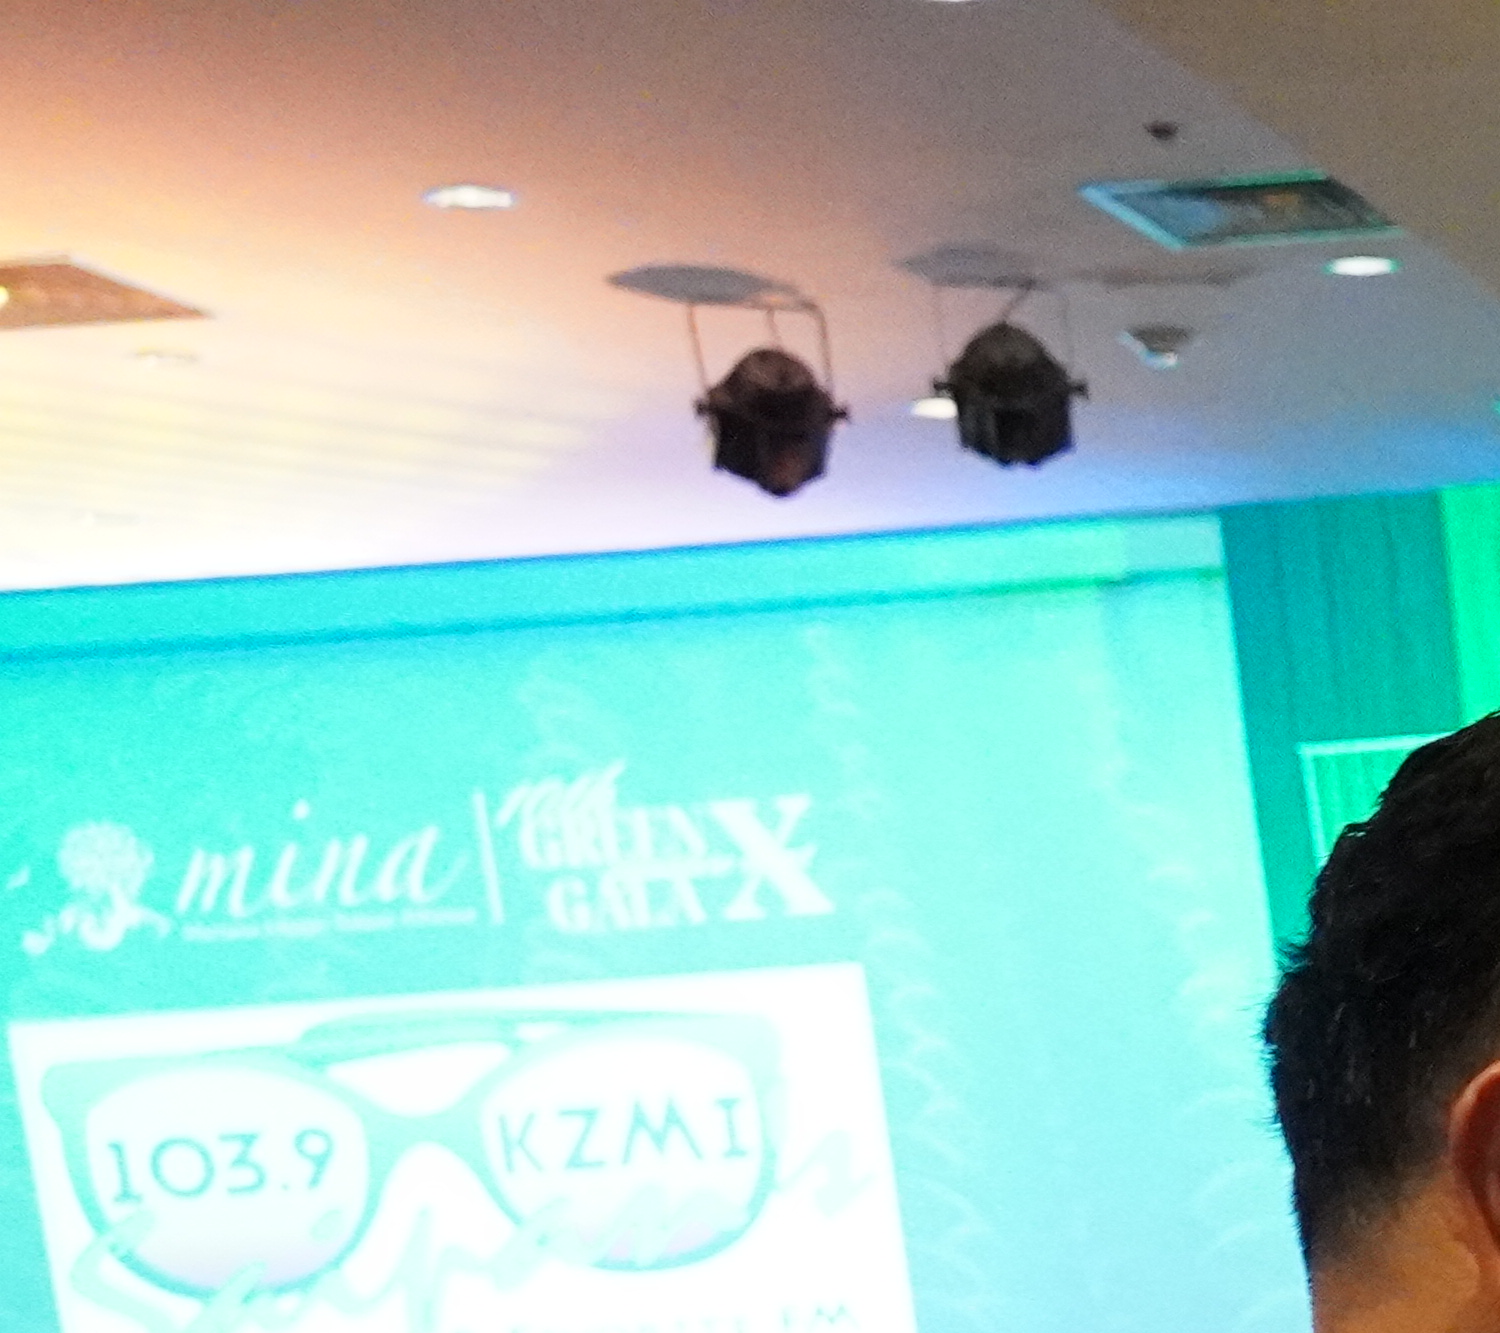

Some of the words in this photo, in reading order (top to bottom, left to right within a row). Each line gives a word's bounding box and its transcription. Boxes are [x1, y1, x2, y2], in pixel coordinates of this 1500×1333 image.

[176, 798, 470, 918] mina
[107, 1126, 337, 1207] 103.9
[498, 1094, 752, 1176] KZMI
